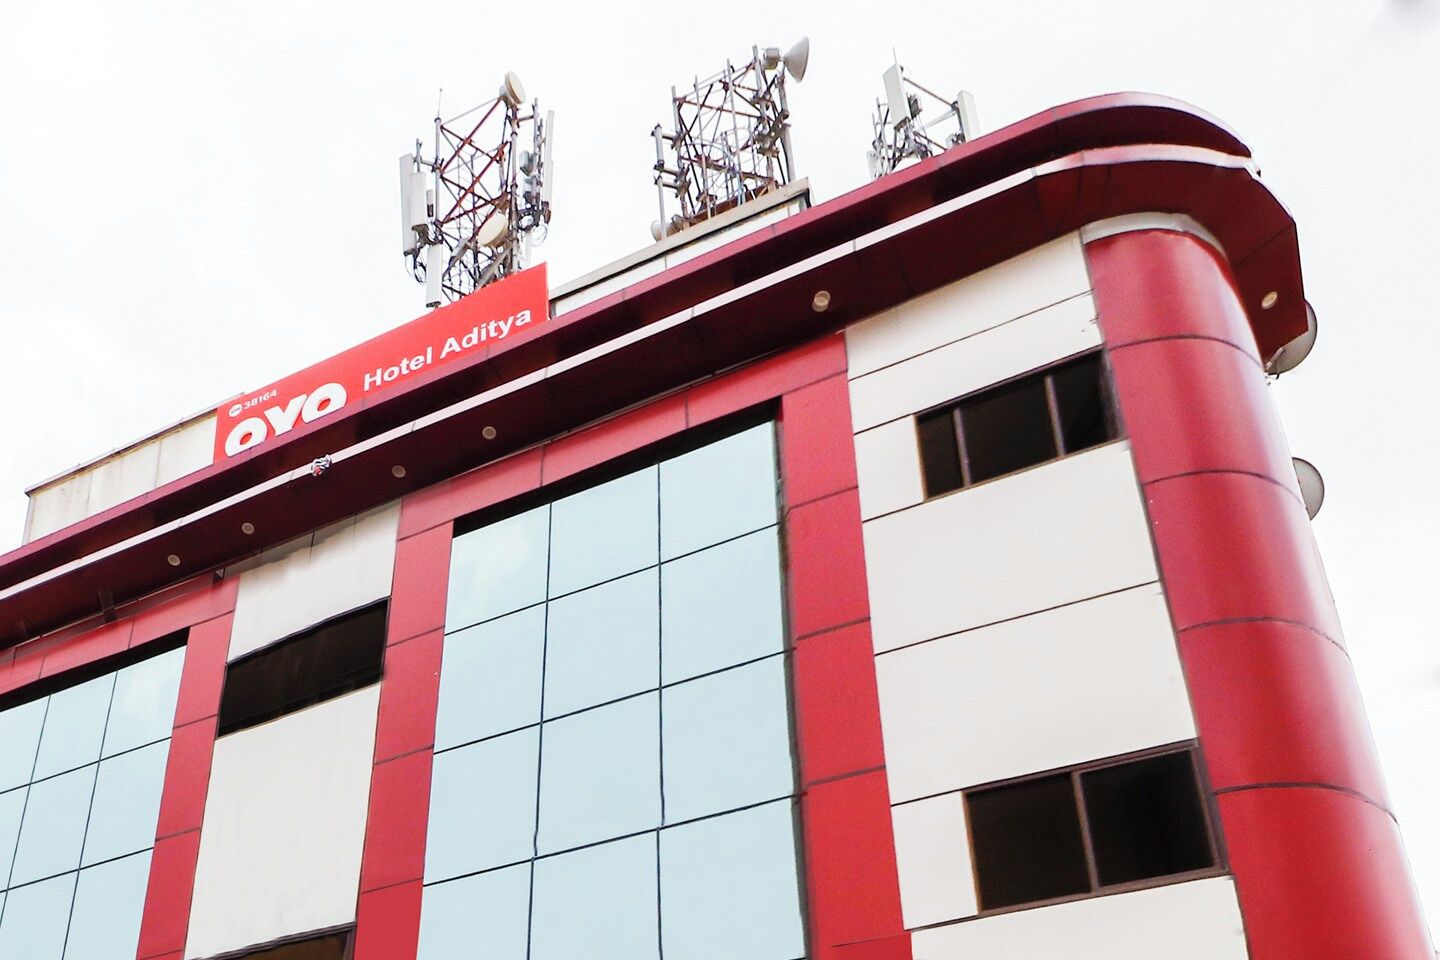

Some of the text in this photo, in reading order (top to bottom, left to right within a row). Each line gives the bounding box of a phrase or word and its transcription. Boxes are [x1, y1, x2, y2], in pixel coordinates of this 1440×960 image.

[363, 309, 532, 392] Hotel Aditya
[224, 382, 347, 458] OYO
